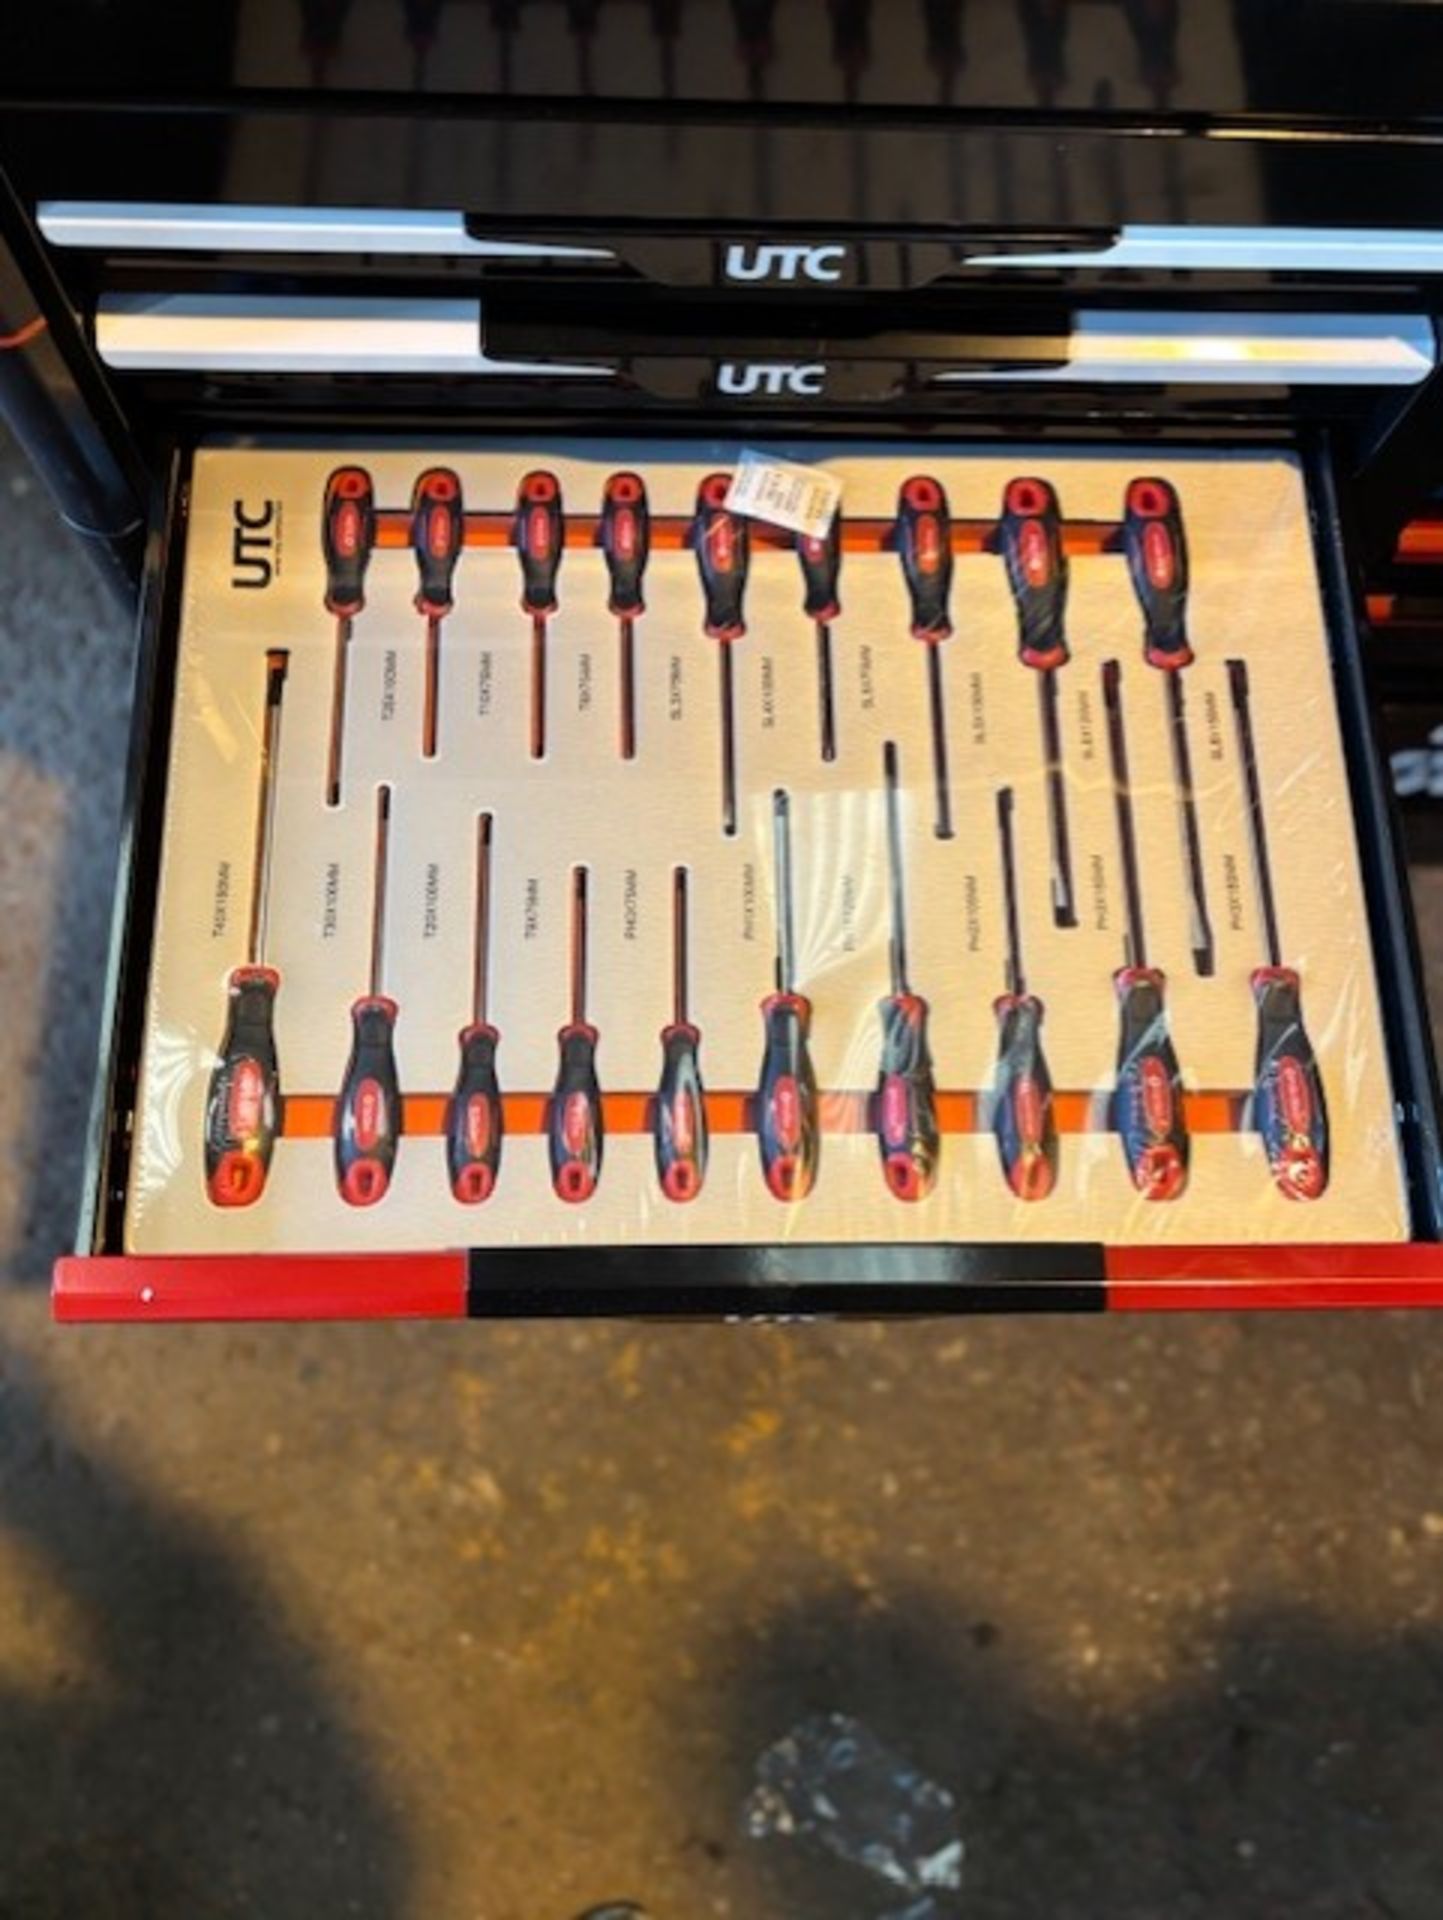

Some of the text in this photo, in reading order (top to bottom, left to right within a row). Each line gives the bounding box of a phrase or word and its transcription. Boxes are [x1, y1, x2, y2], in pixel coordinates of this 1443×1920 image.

[726, 245, 845, 280] UTC
[717, 364, 826, 394] UTC
[232, 500, 272, 588] UTC
